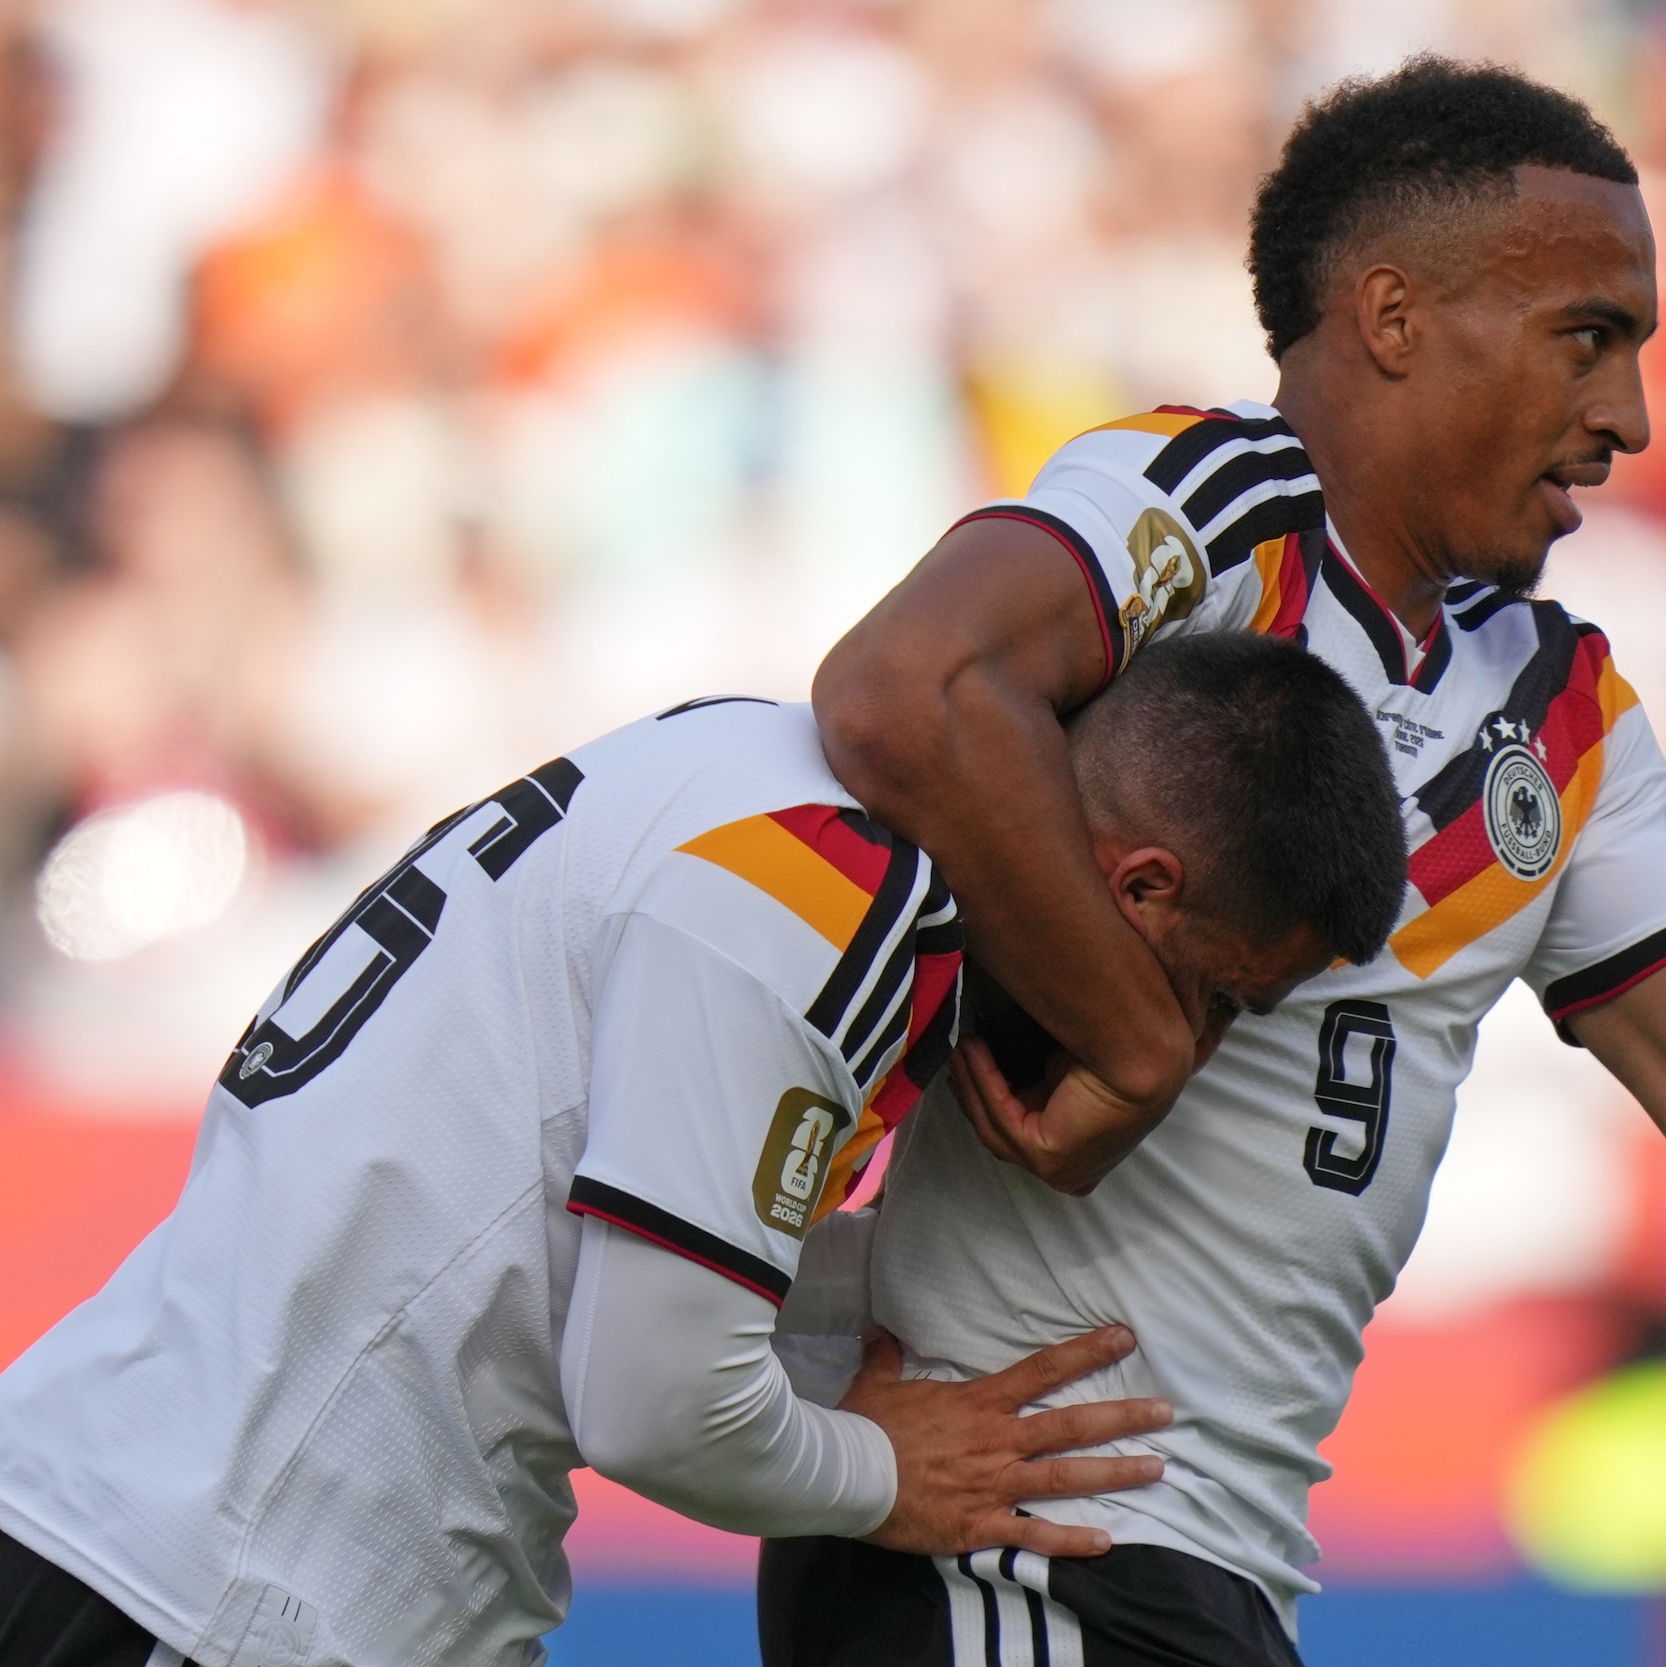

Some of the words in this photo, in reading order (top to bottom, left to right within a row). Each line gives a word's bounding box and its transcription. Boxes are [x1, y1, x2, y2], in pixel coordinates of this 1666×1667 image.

[1503, 766, 1543, 791] DEUTSCHER
[1501, 822, 1552, 860] FUSSBALL-BUND
[1303, 999, 1397, 1197] 9
[790, 1176, 807, 1191] FIFA
[775, 1193, 798, 1211] WORLD
[796, 1202, 807, 1214] CUP
[770, 1204, 804, 1228] 2026
